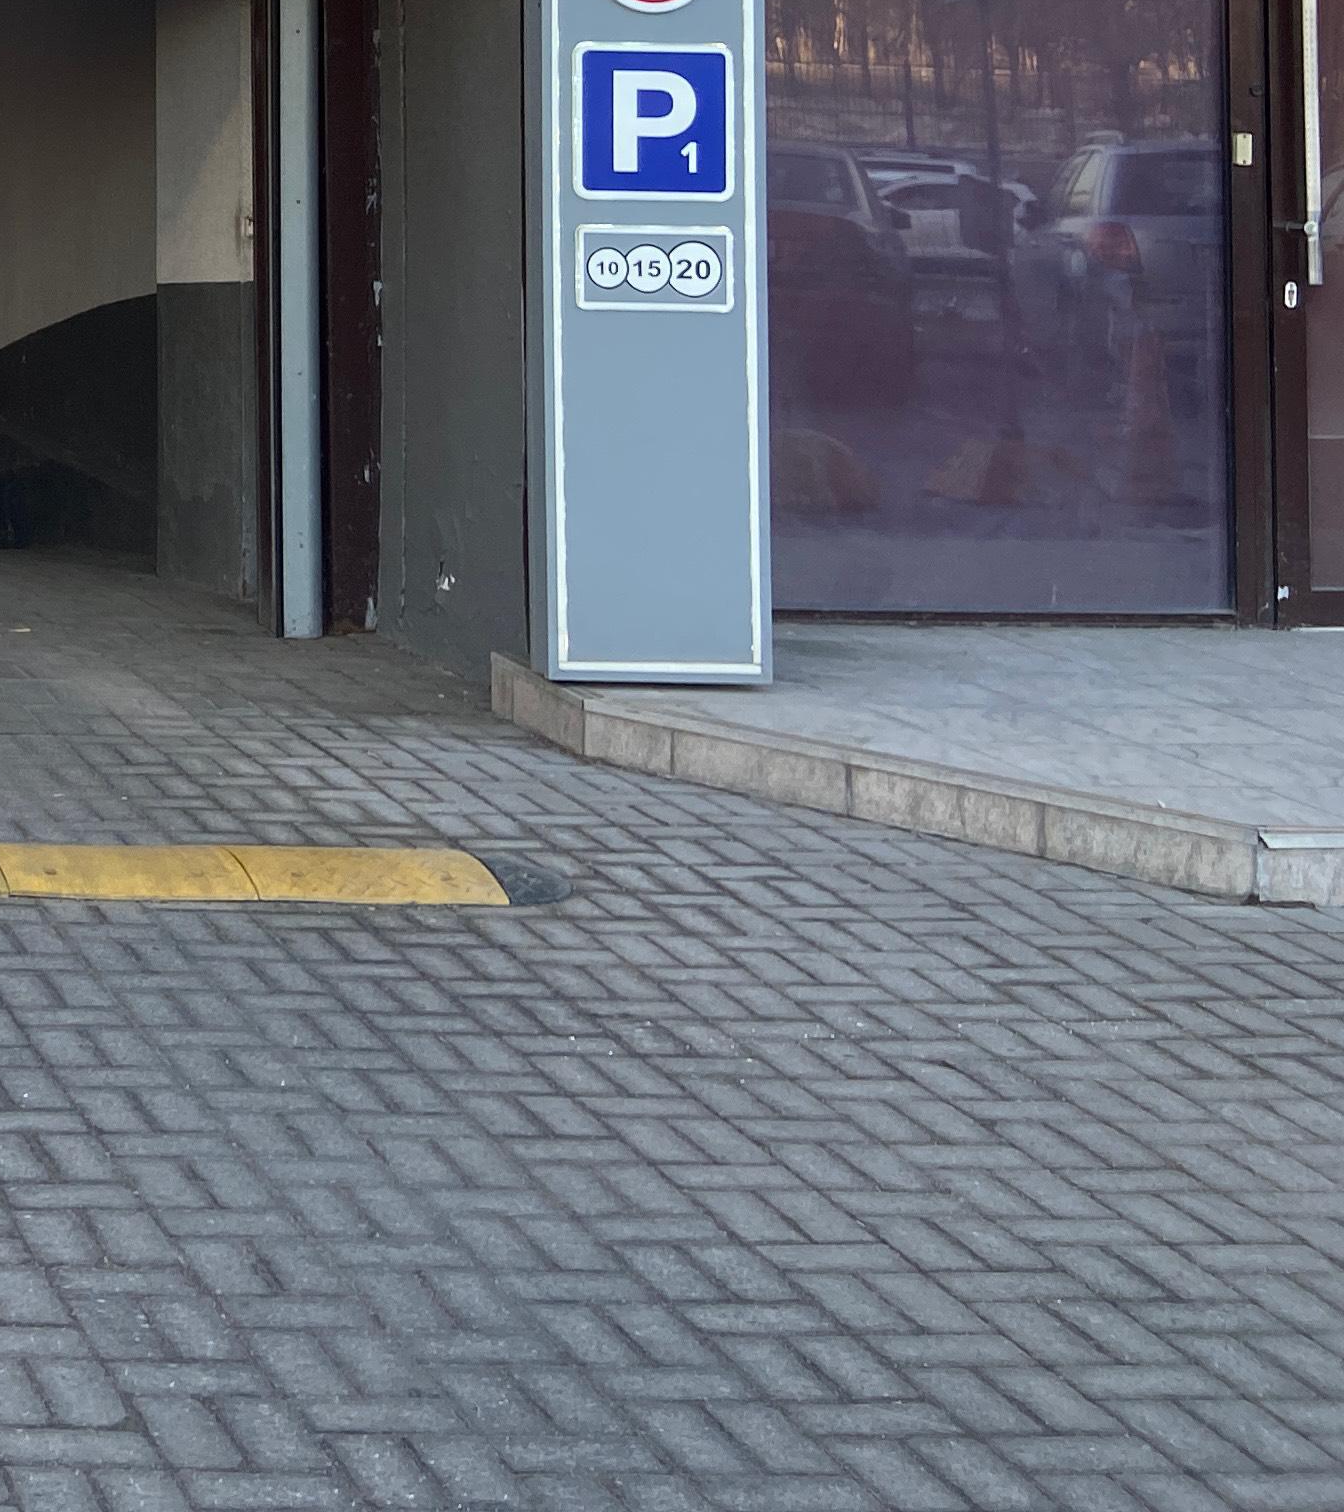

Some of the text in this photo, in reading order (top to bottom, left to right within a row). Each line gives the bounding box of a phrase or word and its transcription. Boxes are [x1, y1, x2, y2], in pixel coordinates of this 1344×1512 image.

[612, 68, 698, 174] P 1
[596, 259, 711, 280] 10 15 20
